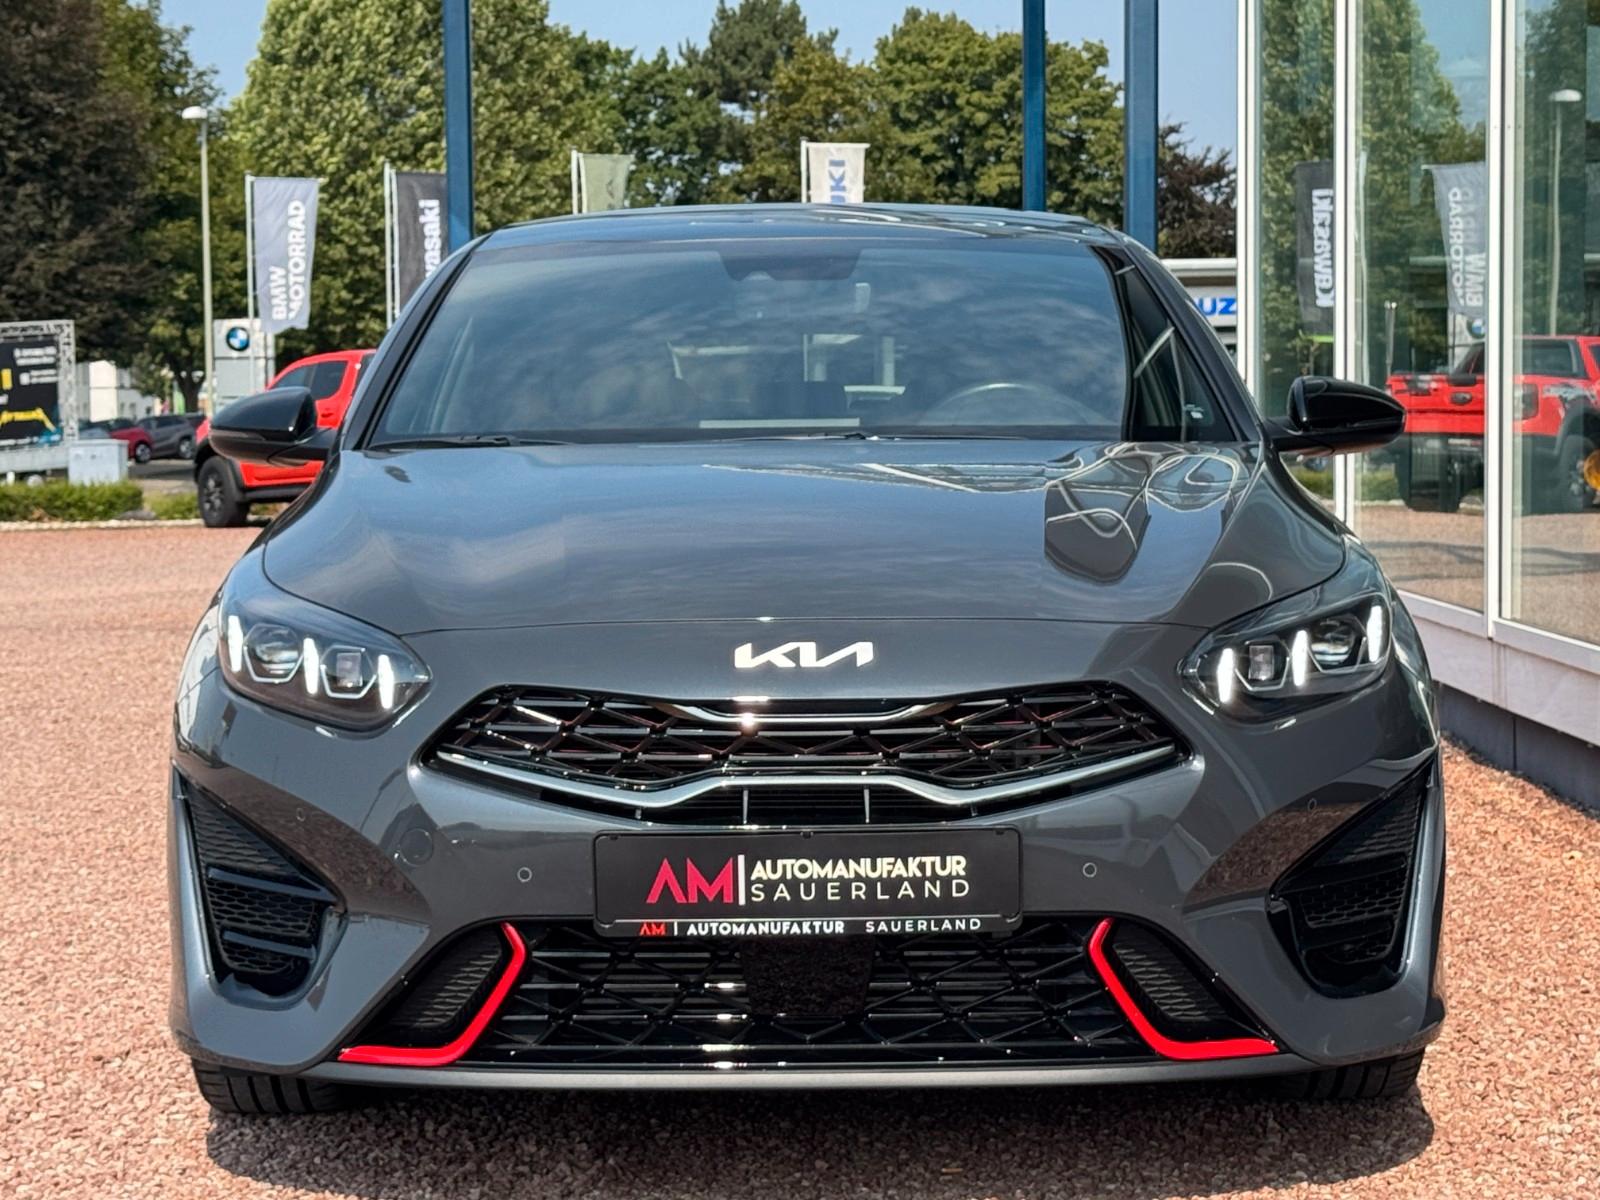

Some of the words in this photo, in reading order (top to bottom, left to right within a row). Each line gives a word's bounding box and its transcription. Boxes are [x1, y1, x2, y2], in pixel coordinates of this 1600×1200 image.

[269, 265, 287, 320] BMW
[735, 641, 874, 668] KIA
[646, 857, 734, 904] AM
[750, 855, 967, 881] AUTOMANUFAKTUR
[751, 879, 970, 902] SAUERLAND
[640, 922, 666, 936] AM
[687, 920, 845, 936] AUTOMANUFAKTUR
[865, 918, 981, 933] SAUERLAND
